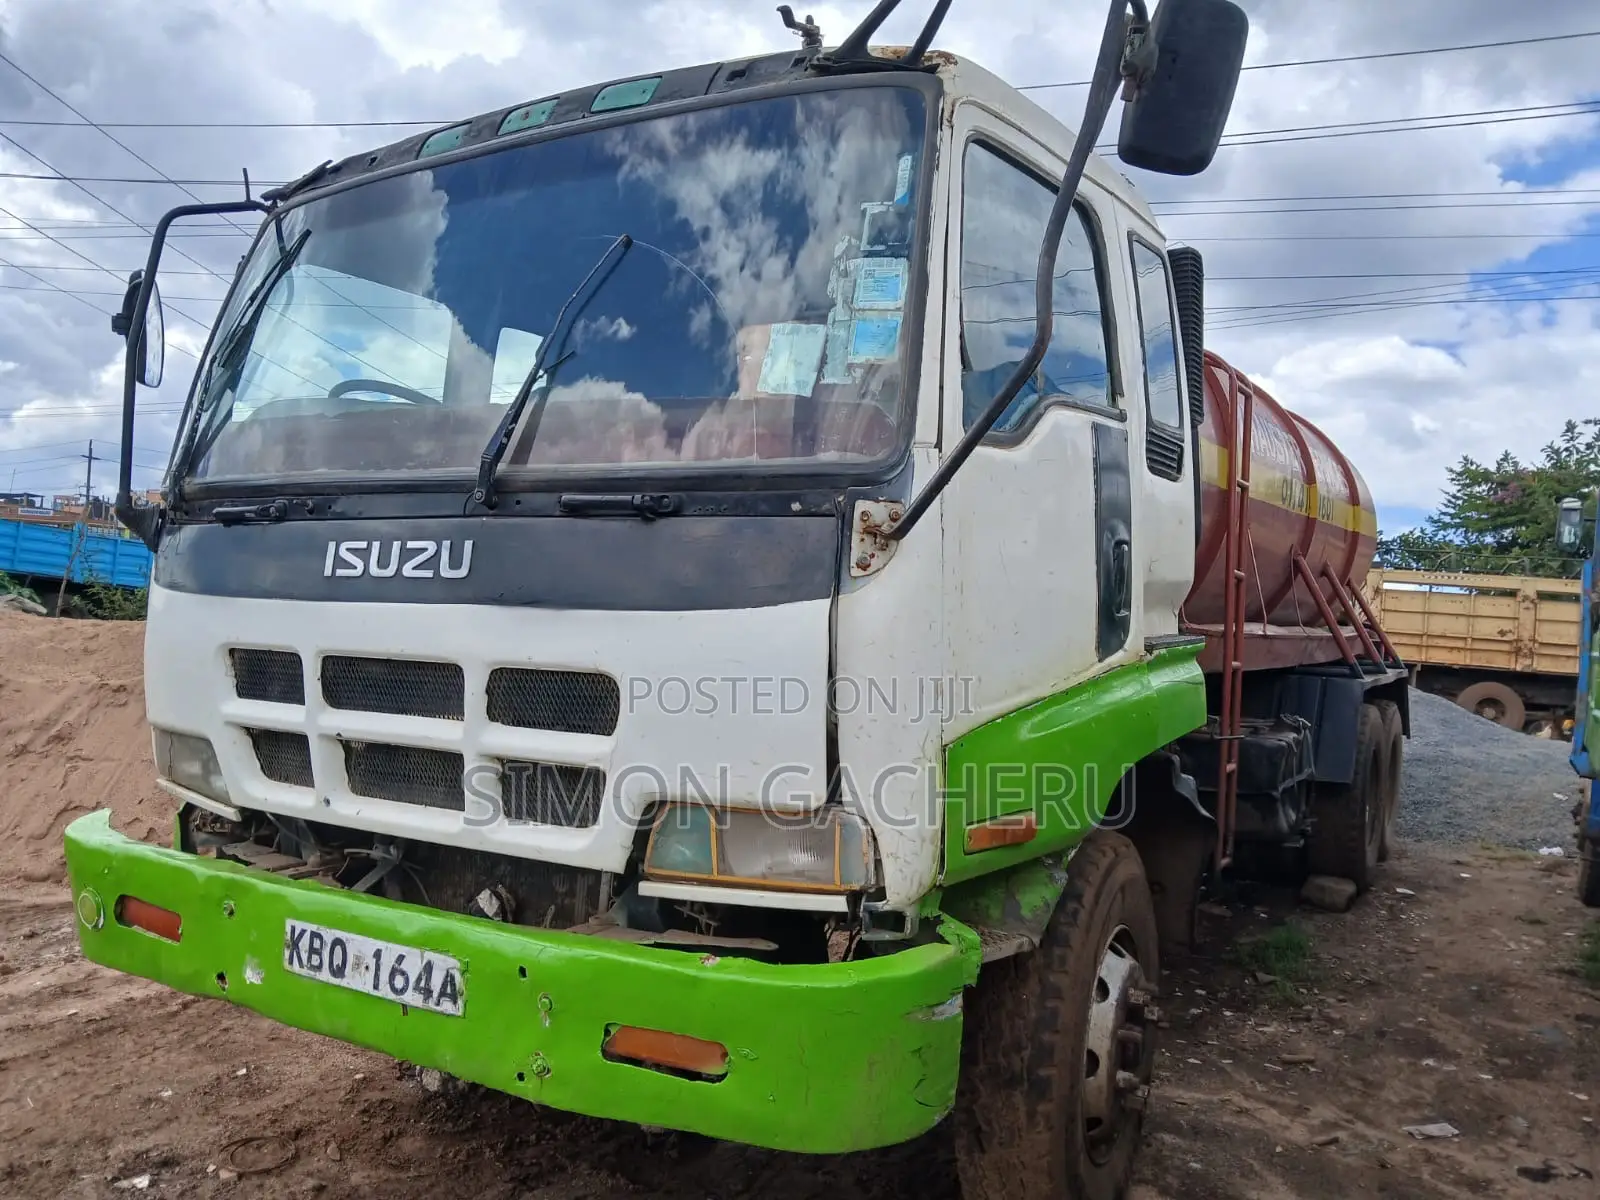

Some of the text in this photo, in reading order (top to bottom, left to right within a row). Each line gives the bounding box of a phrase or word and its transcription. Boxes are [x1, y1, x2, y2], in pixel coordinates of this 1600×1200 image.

[323, 539, 474, 579] ISUZU
[287, 924, 460, 1008] KBQ 164A
